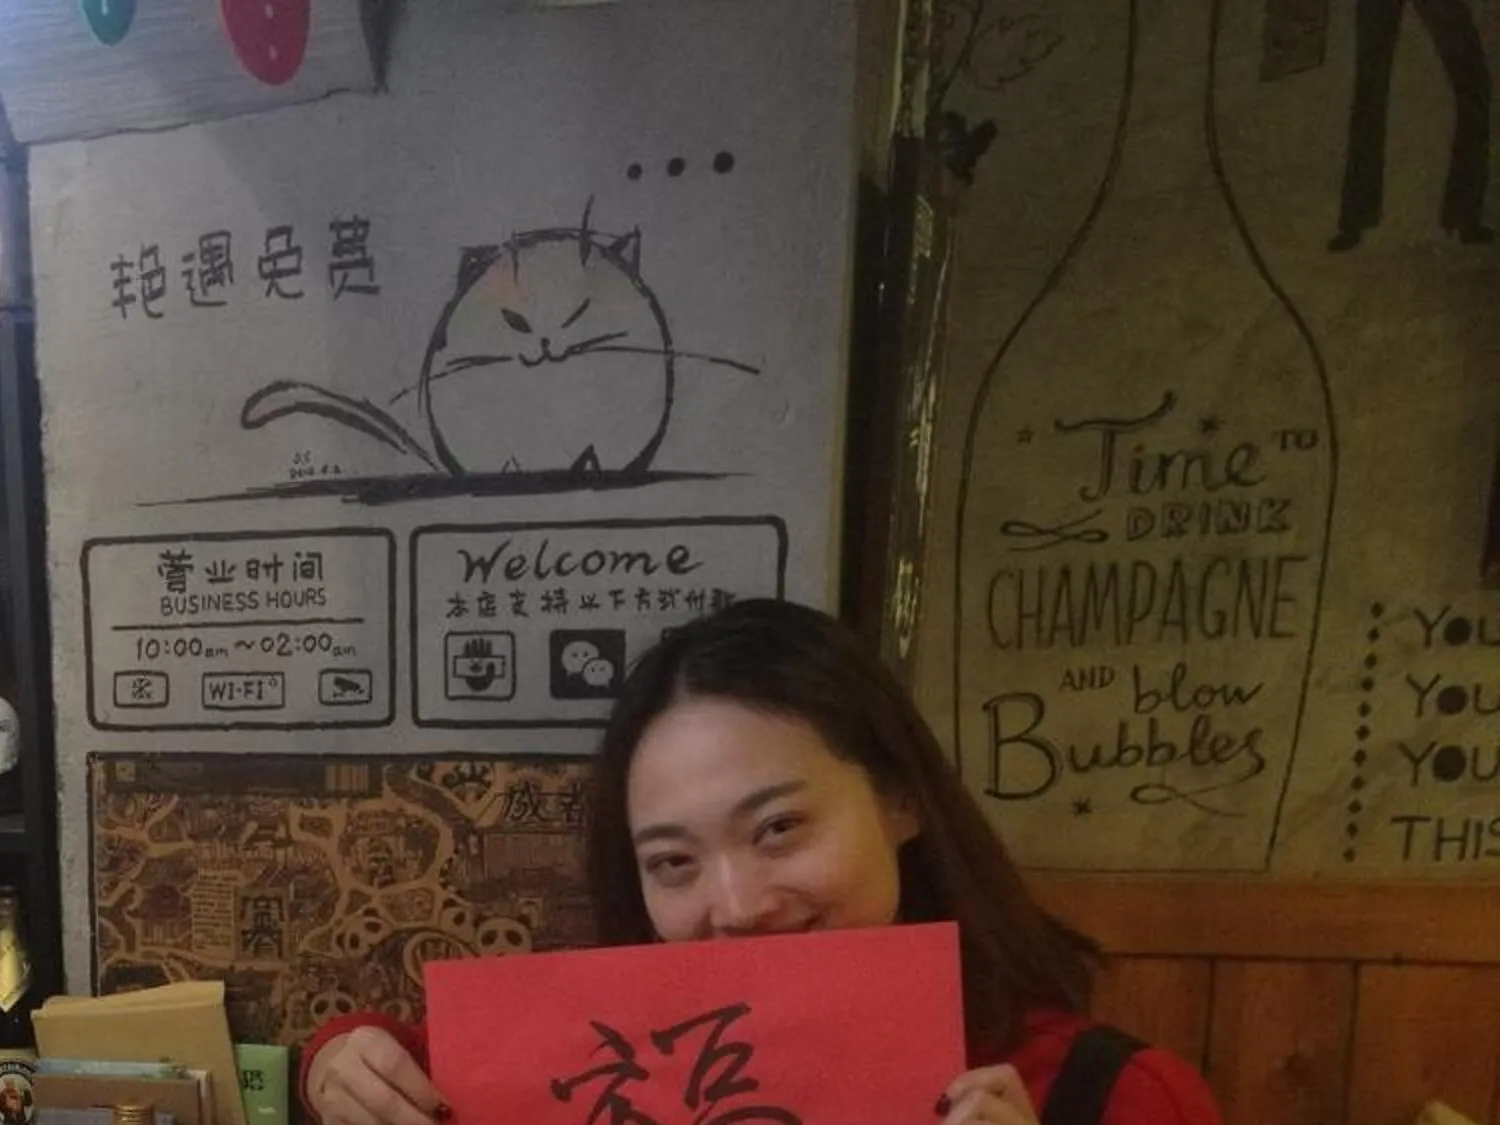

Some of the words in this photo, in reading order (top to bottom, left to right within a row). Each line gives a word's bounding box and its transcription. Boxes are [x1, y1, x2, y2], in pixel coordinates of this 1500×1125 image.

[110, 215, 381, 320] 艳遇免费
[1055, 391, 1268, 503] Time
[1275, 428, 1319, 453] TO
[1126, 498, 1292, 543] DRINK
[157, 549, 324, 593] 营业时间
[457, 538, 704, 583] Welcome
[160, 593, 259, 616] BUSINESS
[265, 589, 328, 610] HOURS
[987, 554, 1311, 650] CHAMPAGNE
[1059, 664, 1116, 691] AND
[1133, 662, 1264, 714] blow
[983, 691, 1267, 800] Bubbles
[1397, 739, 1500, 788] YOU
